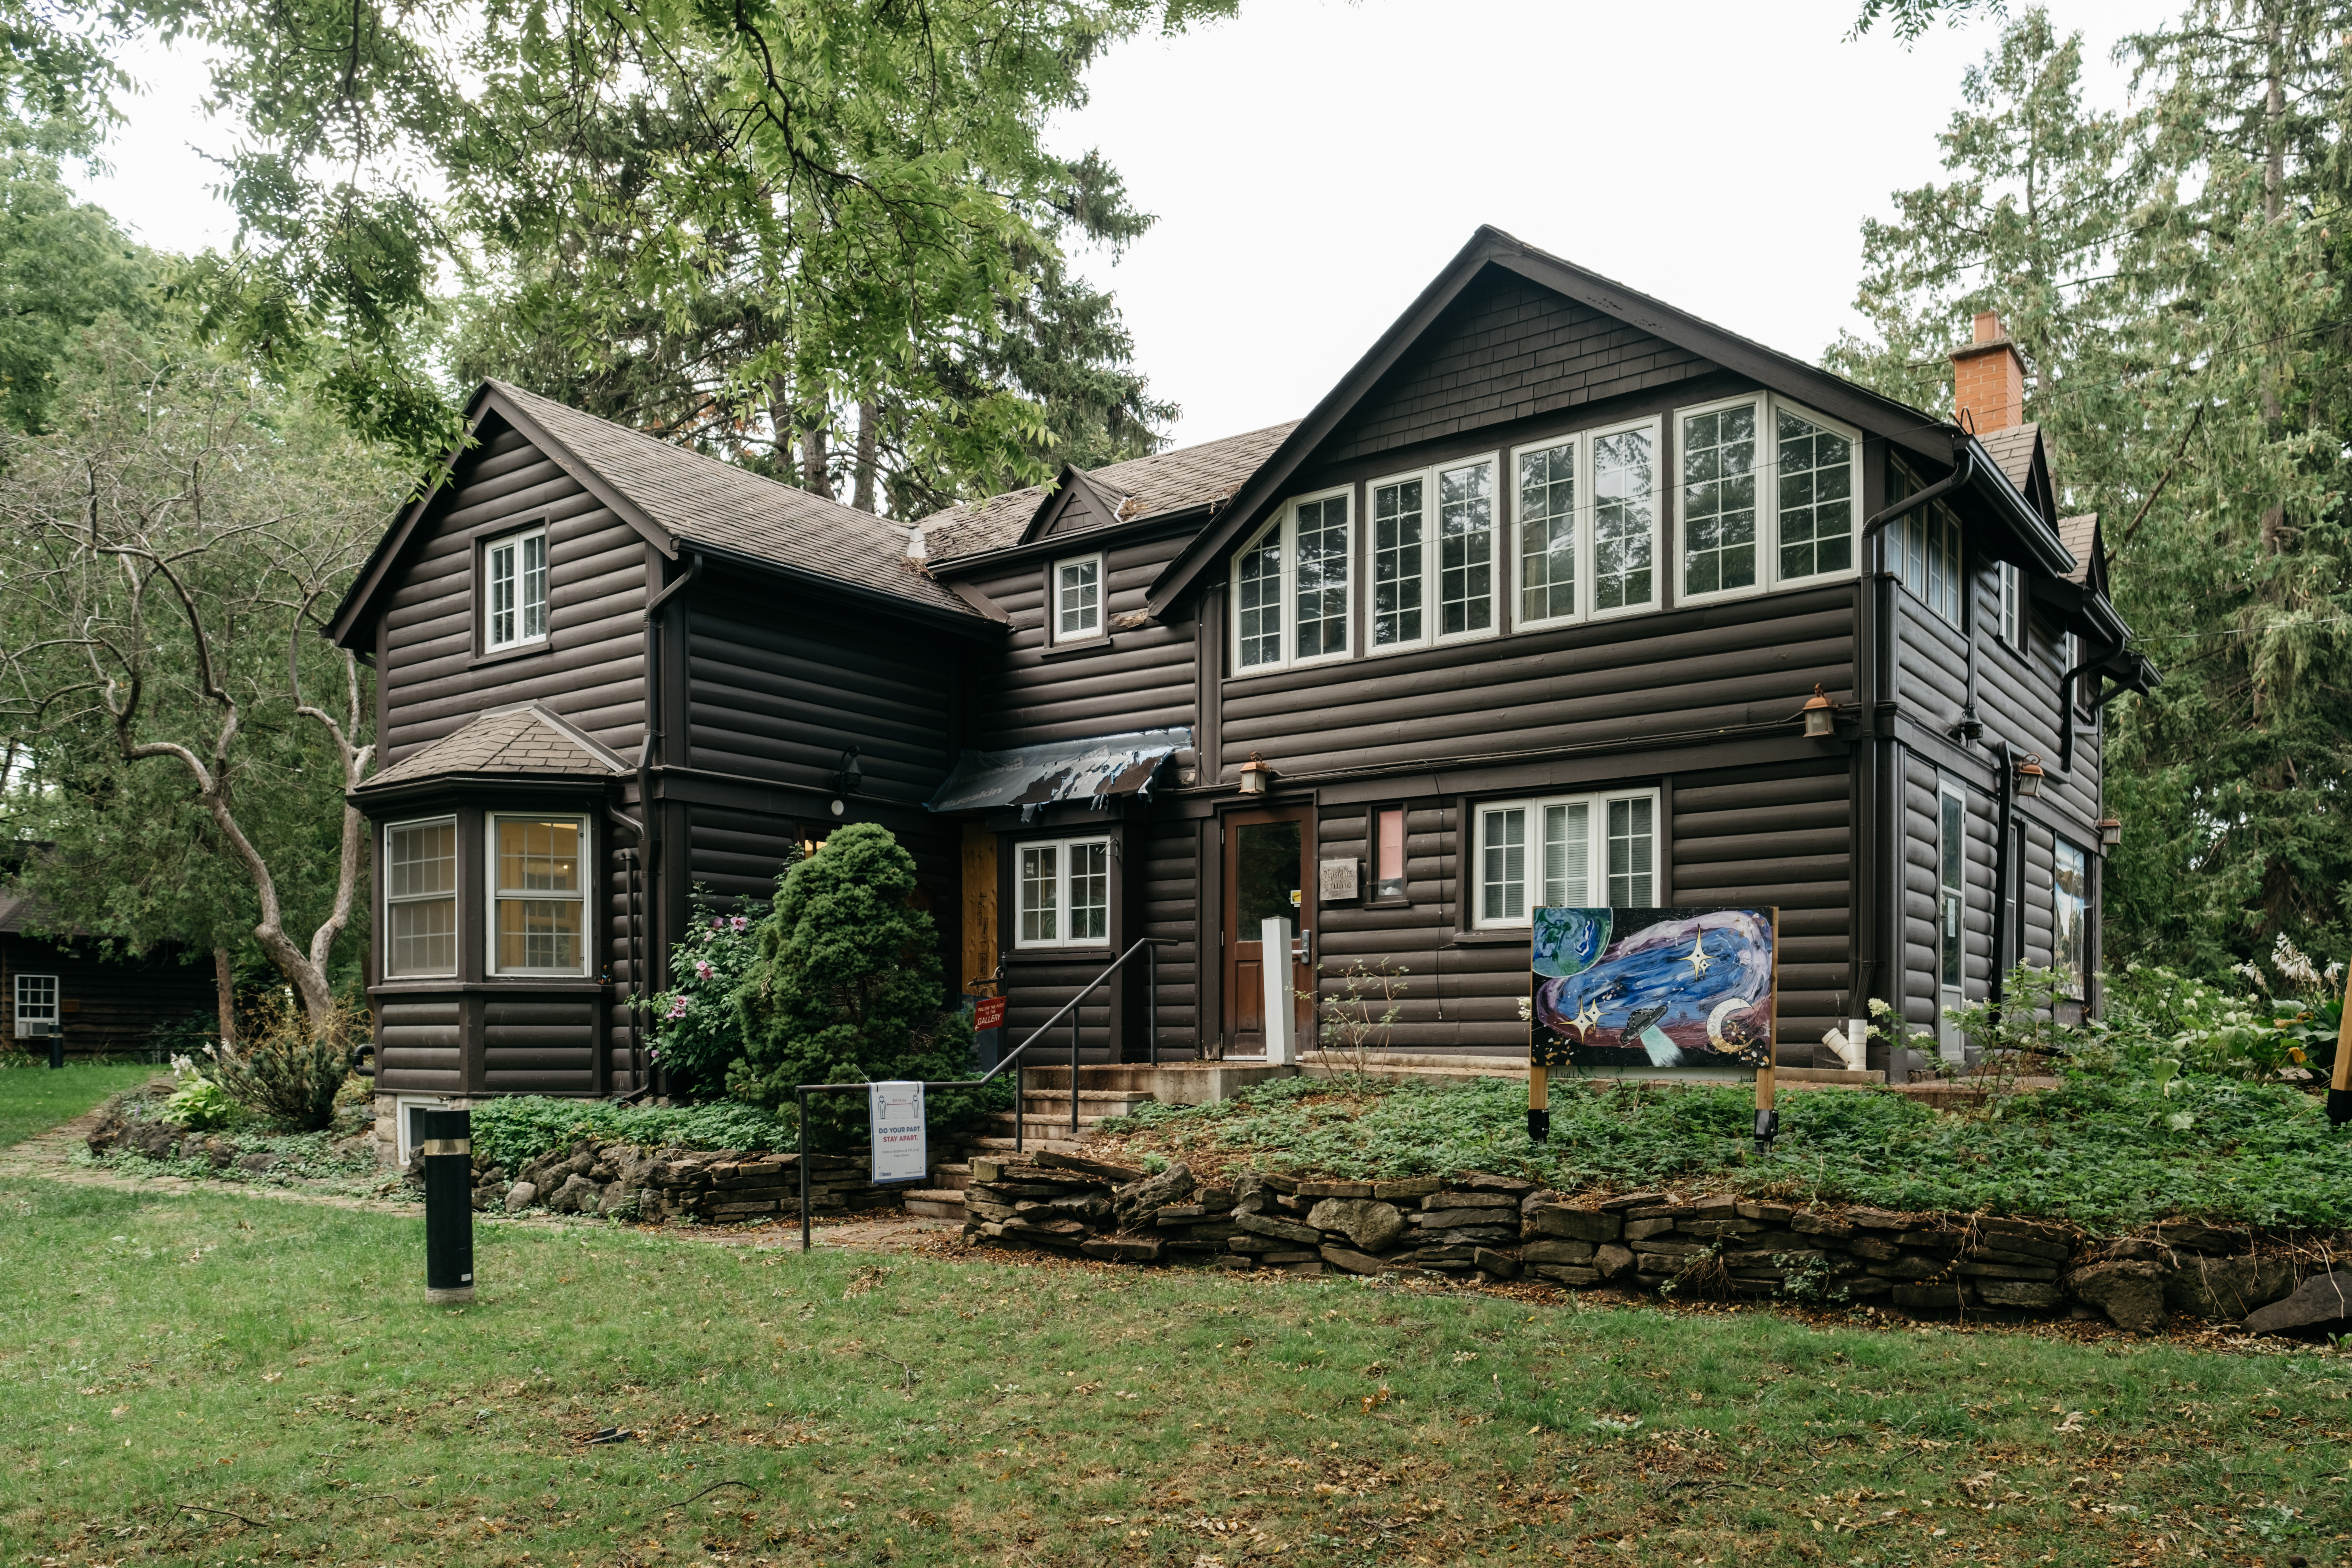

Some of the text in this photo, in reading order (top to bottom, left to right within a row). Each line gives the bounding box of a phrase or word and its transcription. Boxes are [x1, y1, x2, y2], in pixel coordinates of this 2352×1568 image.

[937, 788, 1003, 810] Blueskin
[1324, 867, 1353, 881] Upstairs
[978, 1013, 1001, 1025] GALLERY
